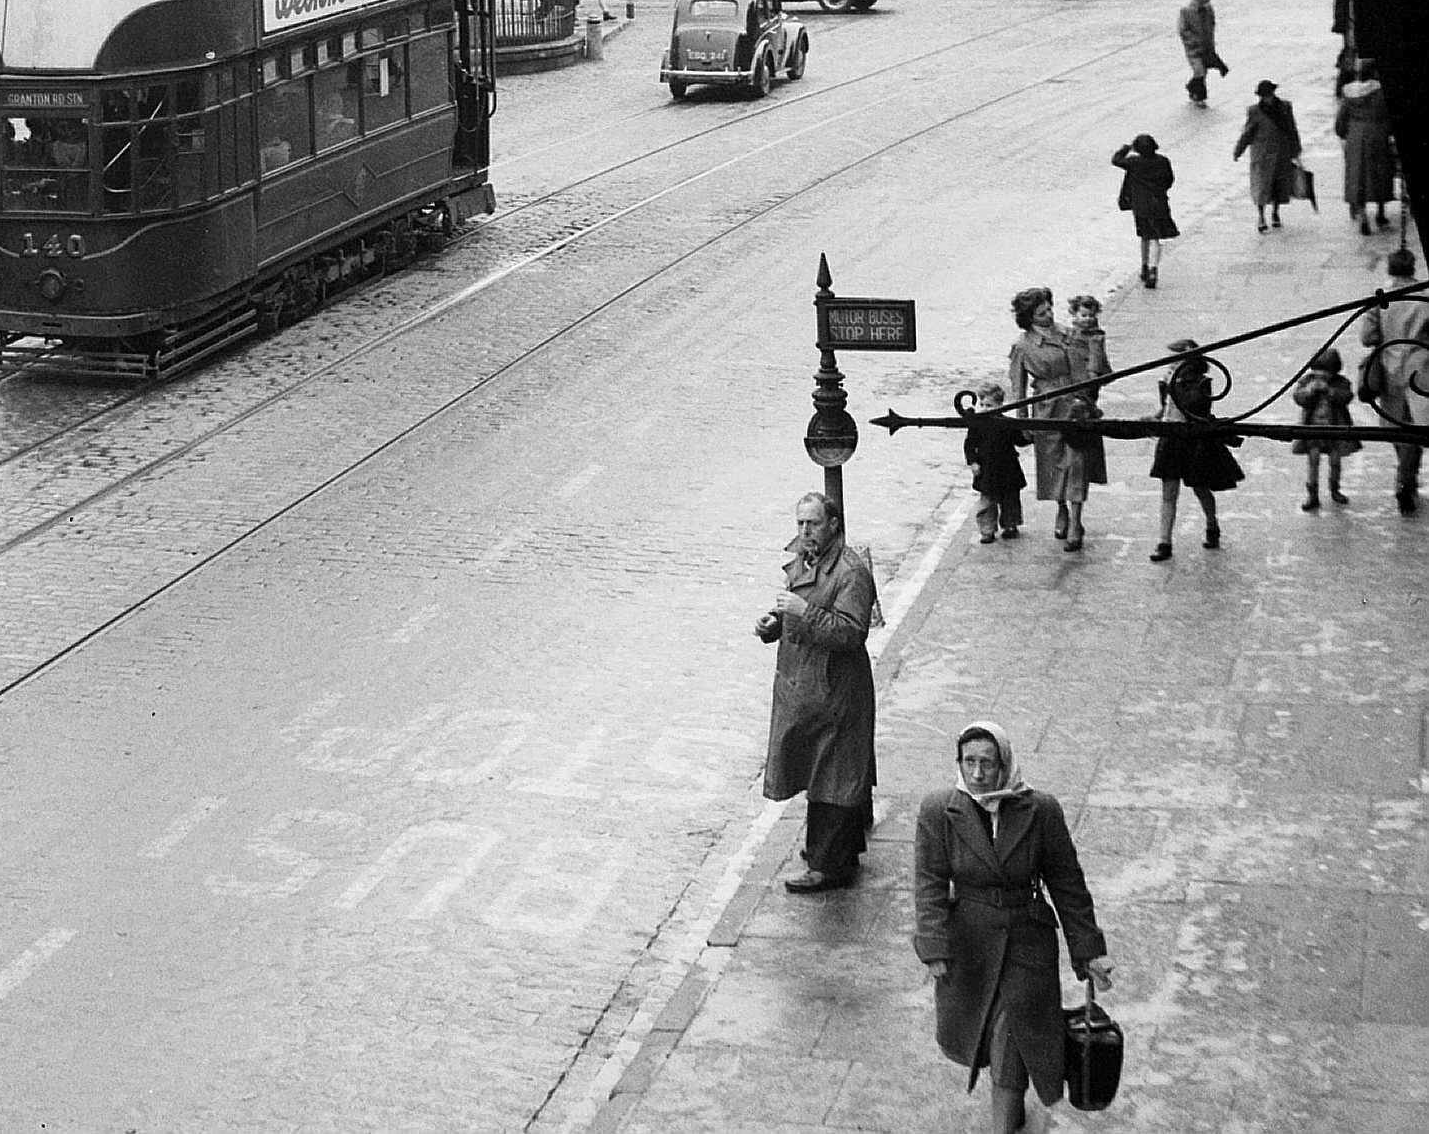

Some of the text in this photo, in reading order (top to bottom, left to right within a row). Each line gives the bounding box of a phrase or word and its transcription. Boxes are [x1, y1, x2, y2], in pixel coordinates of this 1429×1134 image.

[7, 92, 51, 107] GRANTON
[23, 233, 85, 257] 140
[828, 309, 904, 325] MOTOR BUSES
[829, 326, 904, 341] STOP HERE
